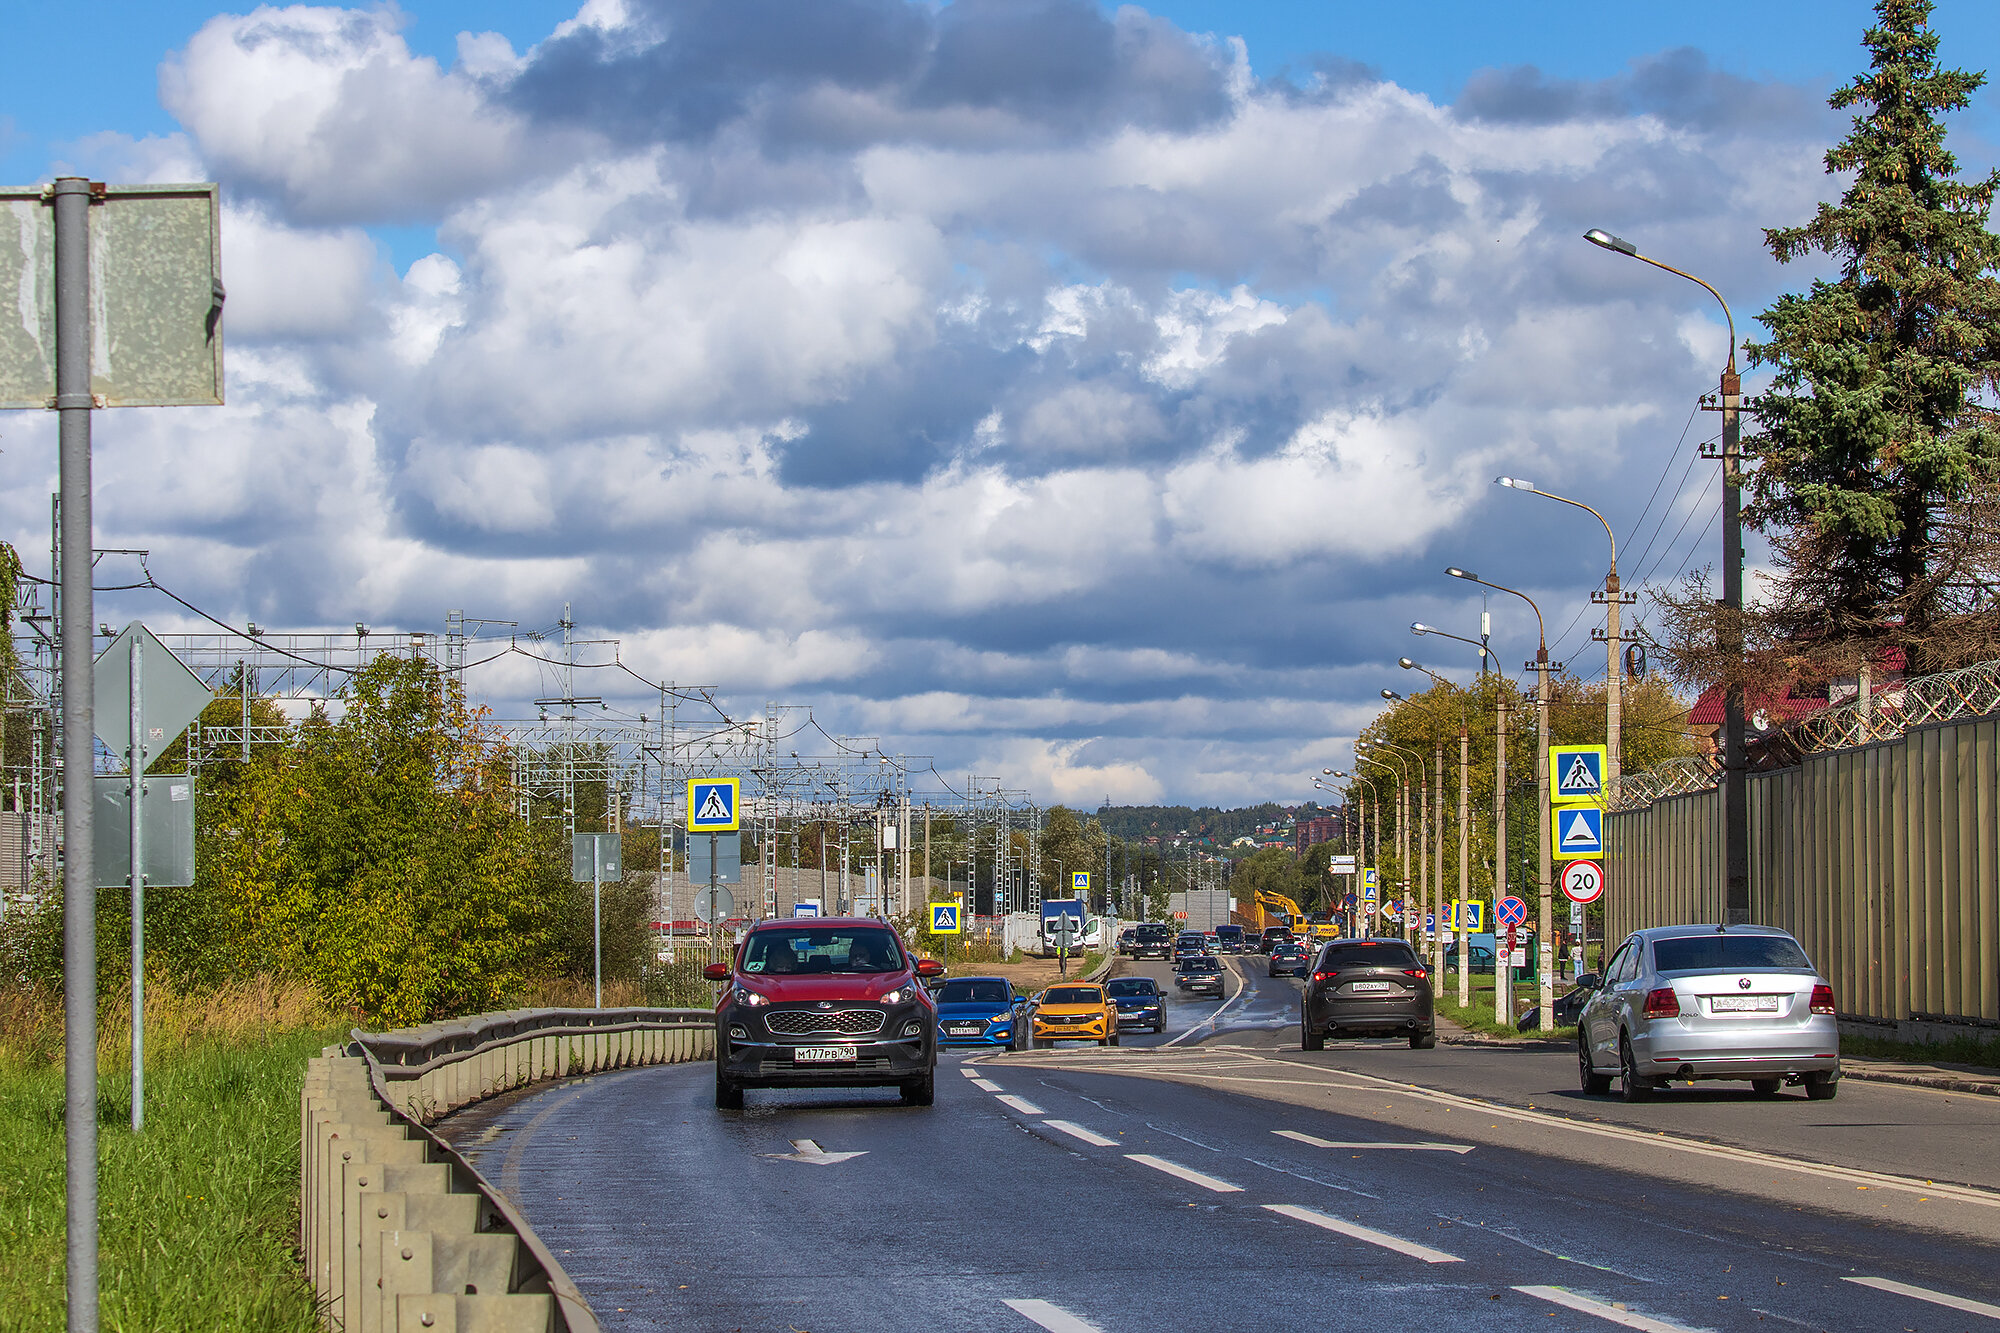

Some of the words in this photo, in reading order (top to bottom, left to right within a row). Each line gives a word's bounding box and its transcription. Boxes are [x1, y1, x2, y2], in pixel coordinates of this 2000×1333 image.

[1572, 873, 1595, 890] 20
[797, 1048, 838, 1059] М177РВ
[839, 1047, 855, 1056] 790
